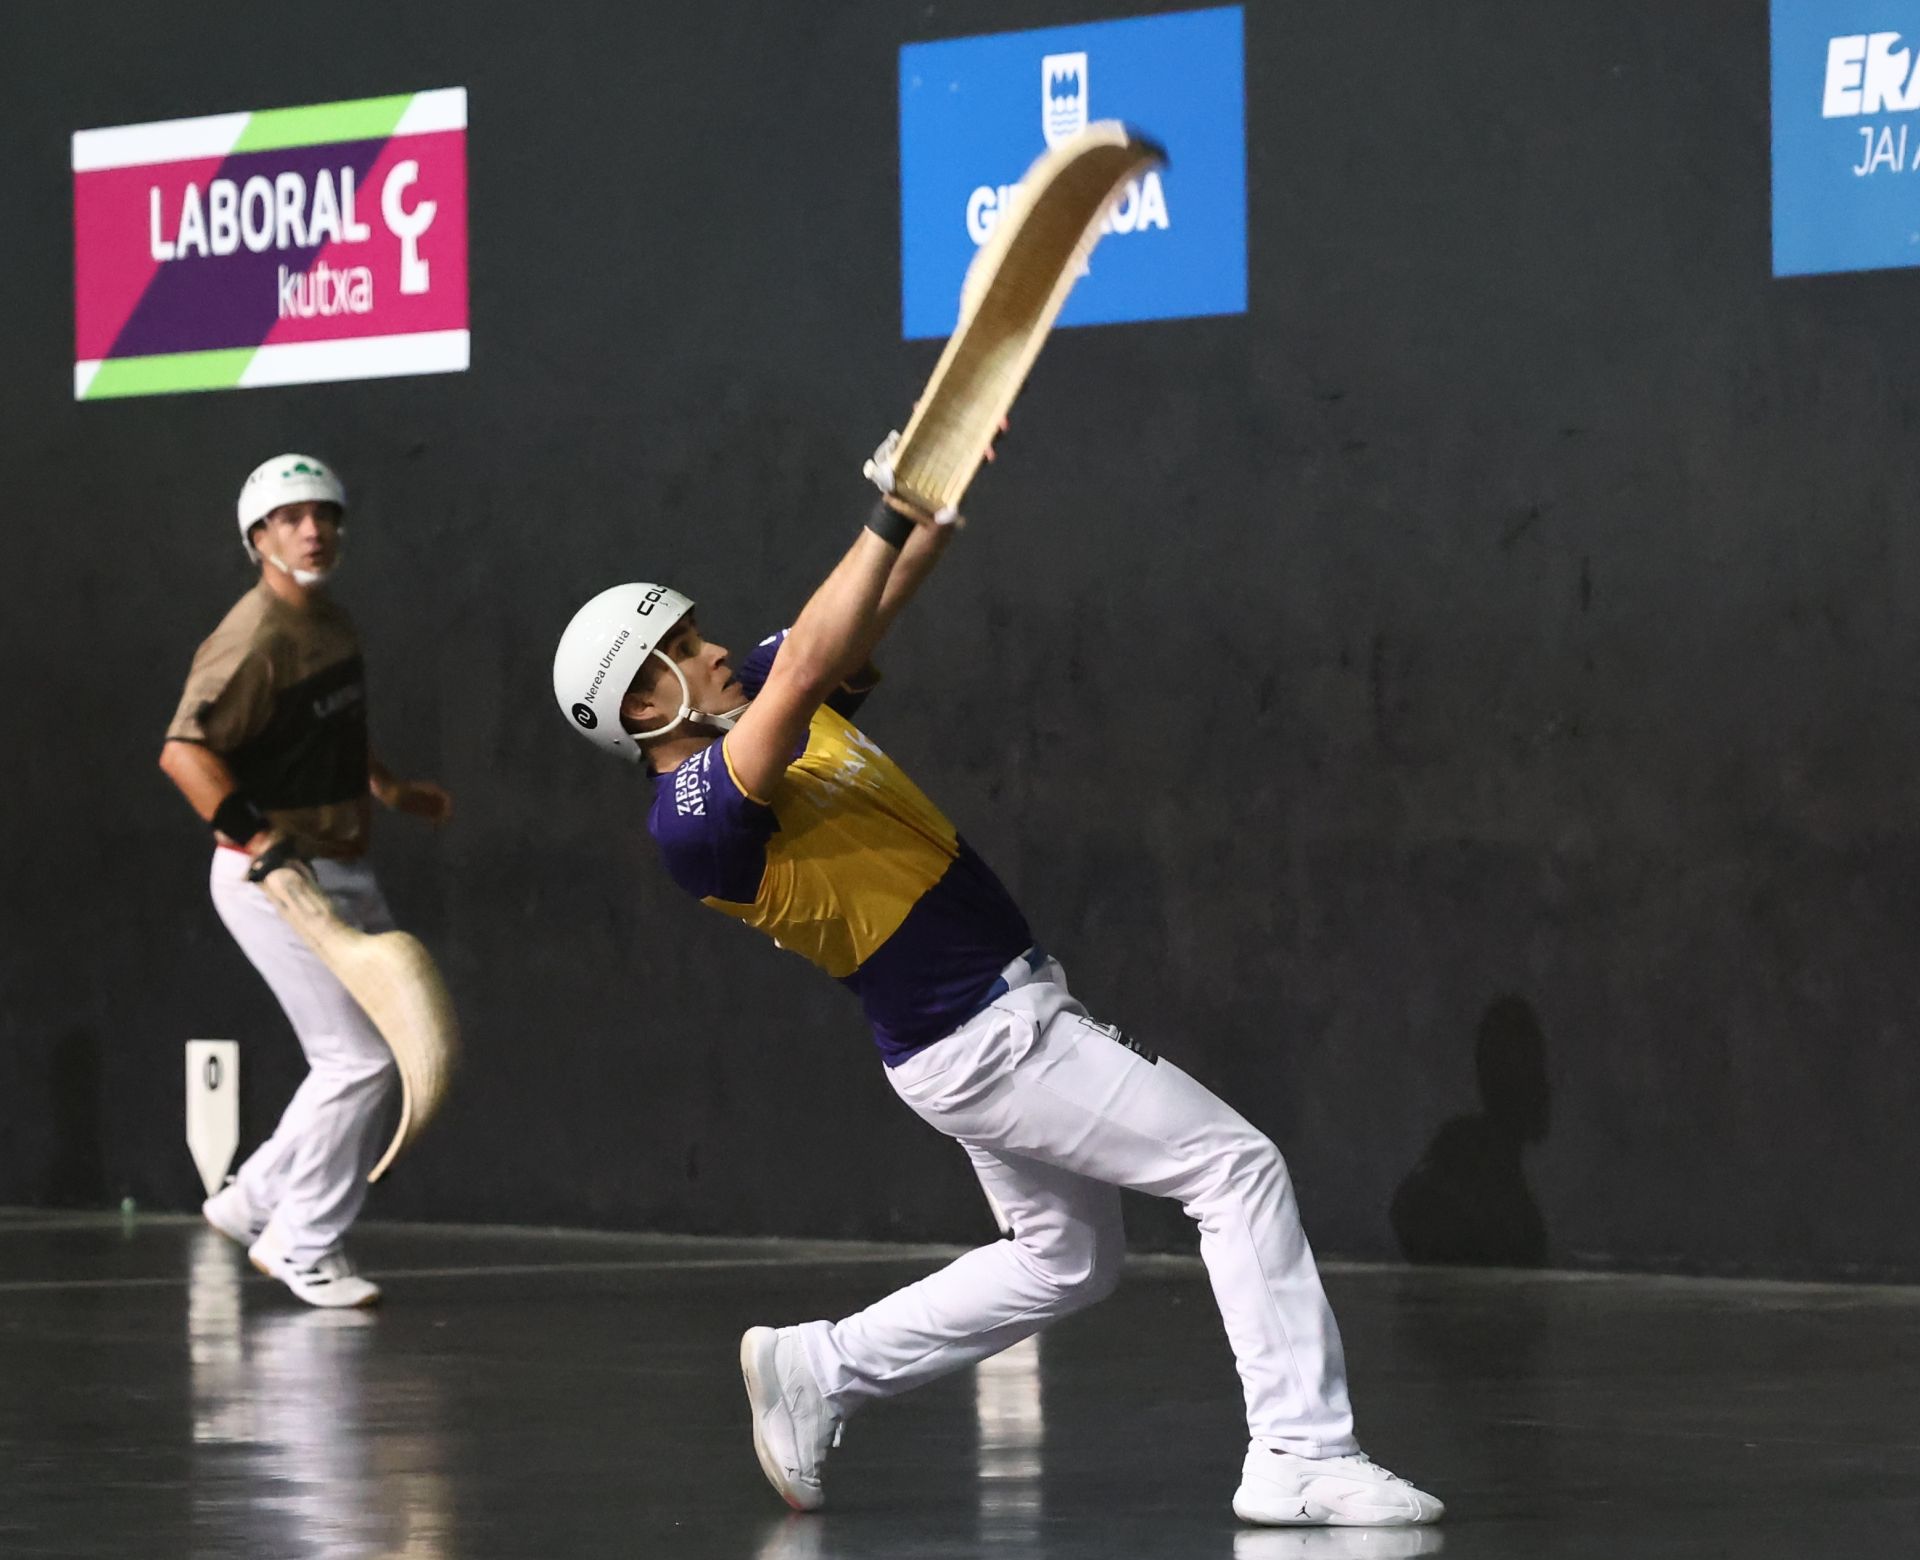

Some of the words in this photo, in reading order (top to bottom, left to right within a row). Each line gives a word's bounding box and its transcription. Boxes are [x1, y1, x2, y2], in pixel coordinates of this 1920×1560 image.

[1853, 124, 1908, 176] JAI
[150, 166, 371, 261] LABORAL
[278, 261, 373, 319] kutxa
[637, 584, 668, 616] COL
[584, 670, 606, 704] Nerea
[600, 630, 630, 669] Urrutia
